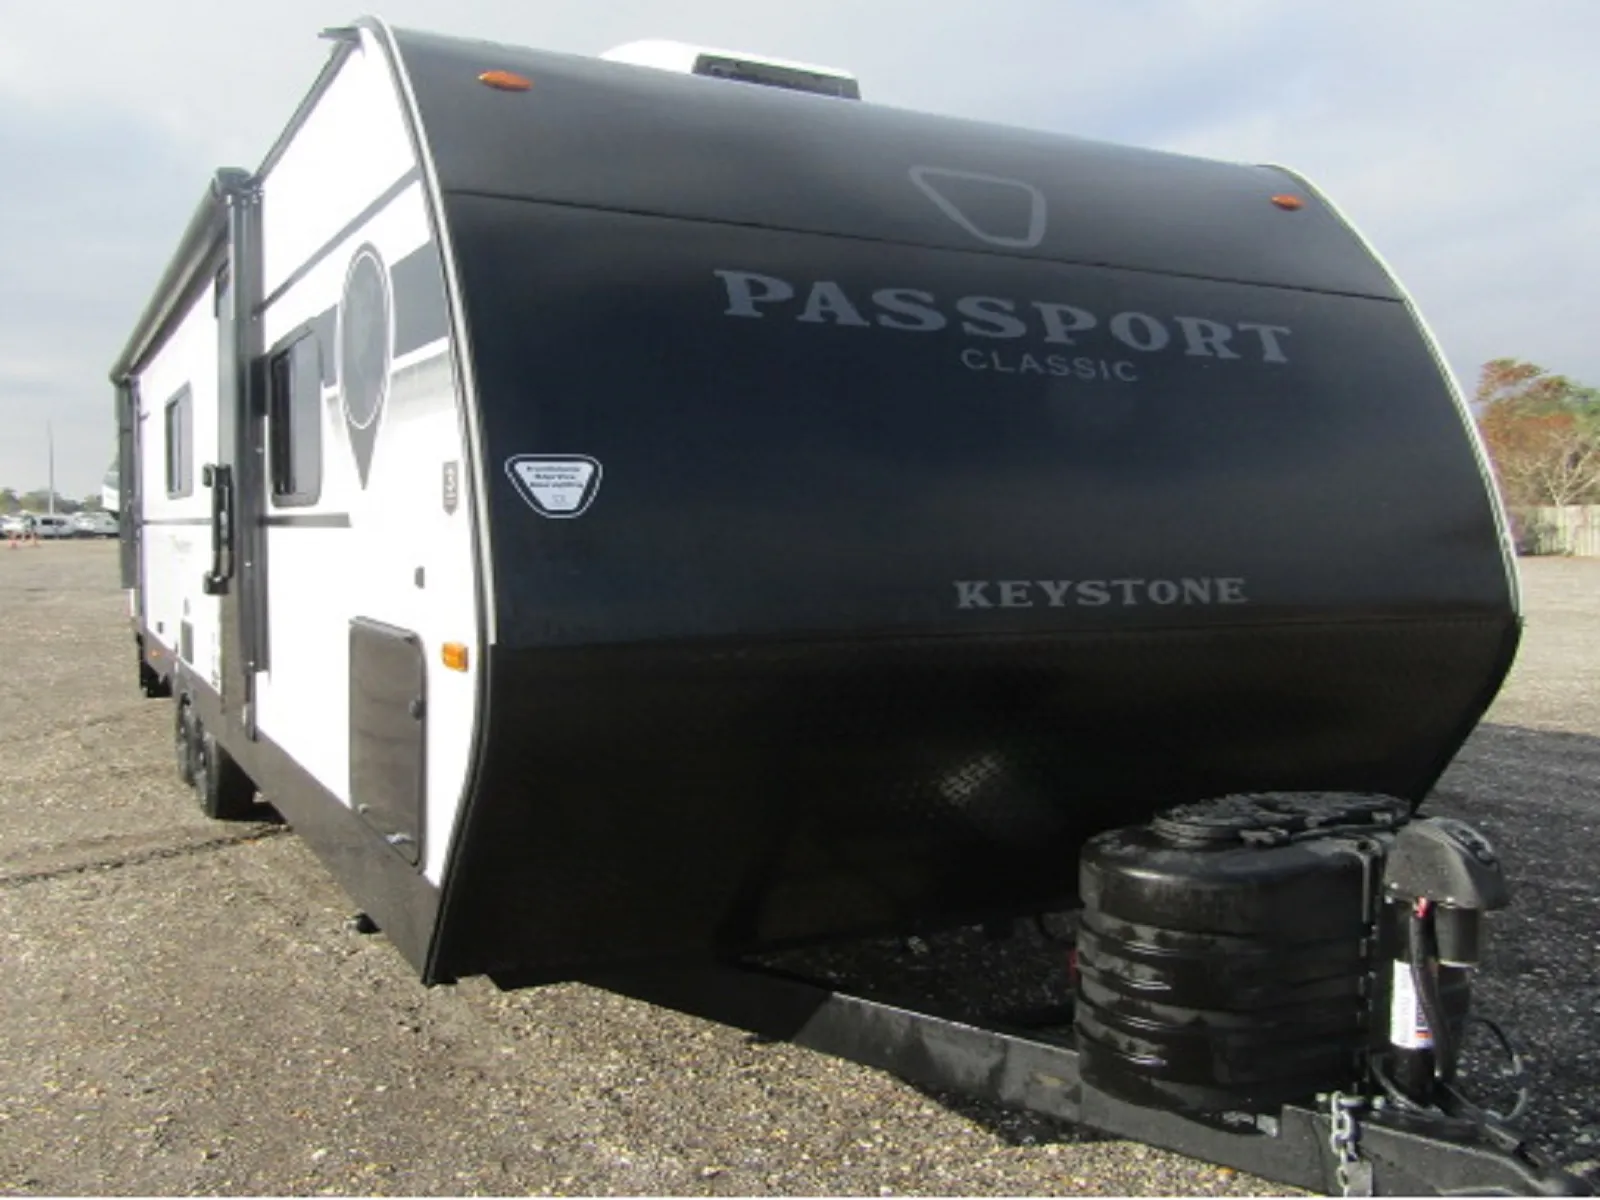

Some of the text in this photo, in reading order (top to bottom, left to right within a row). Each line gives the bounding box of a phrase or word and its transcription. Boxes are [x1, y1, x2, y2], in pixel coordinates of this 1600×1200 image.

[714, 269, 1292, 363] PASSPORT
[960, 348, 1138, 382] CLASSIC
[953, 577, 1248, 609] KEYSTONE
